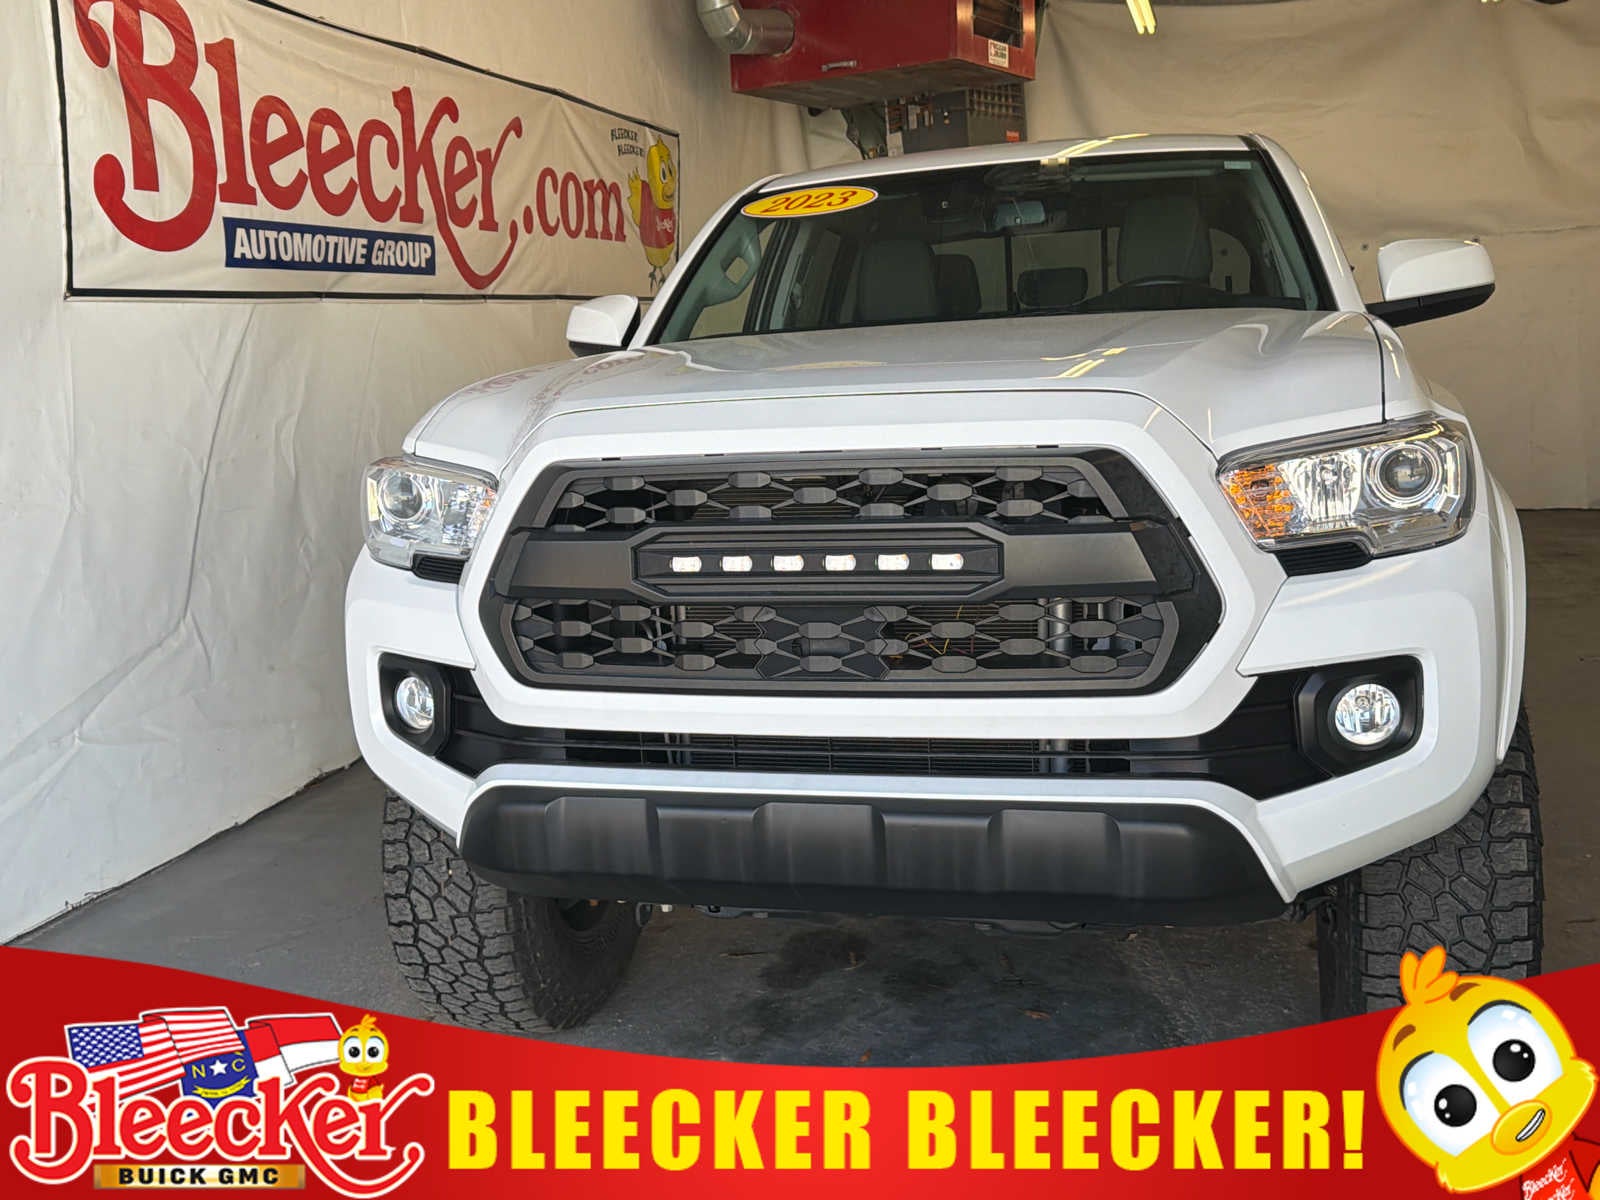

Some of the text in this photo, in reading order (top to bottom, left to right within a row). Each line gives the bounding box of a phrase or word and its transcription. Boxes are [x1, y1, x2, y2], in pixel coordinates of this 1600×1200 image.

[761, 189, 859, 214] 2023
[233, 227, 432, 268] AUTOMOTIVE GROUP
